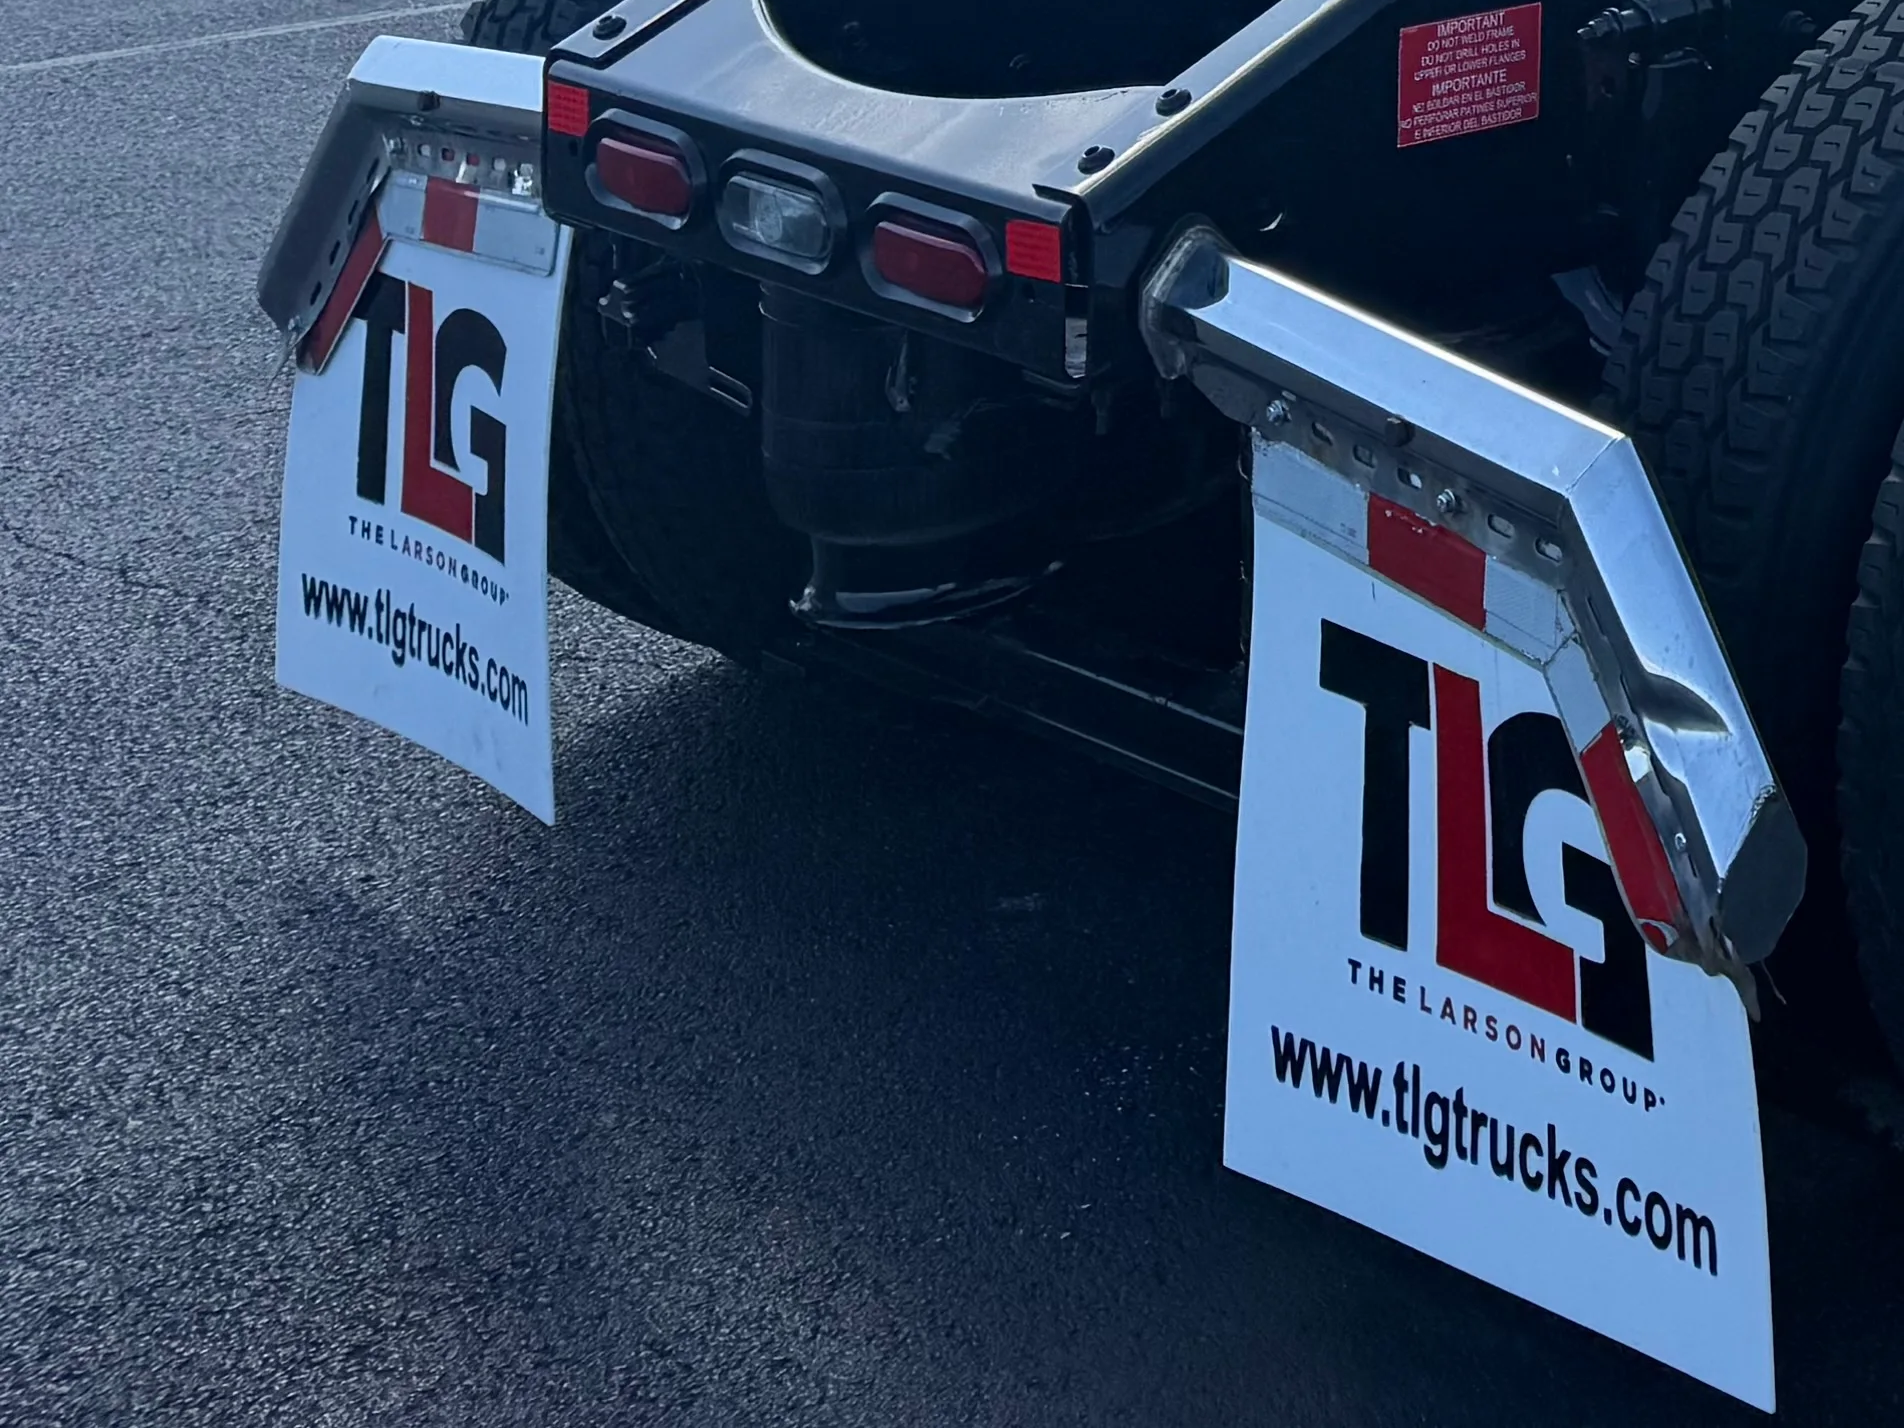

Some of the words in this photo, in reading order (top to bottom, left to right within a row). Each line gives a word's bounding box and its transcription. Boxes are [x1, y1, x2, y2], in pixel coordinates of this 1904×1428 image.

[1438, 11, 1505, 37] IMPORTANT
[1442, 36, 1459, 48] NOT
[1486, 26, 1514, 40] FRAME
[1444, 64, 1456, 75] OR
[1488, 50, 1526, 65] FLANGES
[1456, 47, 1478, 60] DRILL
[1482, 42, 1509, 54] HOLES
[1512, 38, 1520, 47] IN
[1432, 68, 1507, 96] IMPORTANTE
[1474, 90, 1484, 100] EL
[1482, 108, 1522, 125] BASTIDOR
[349, 271, 508, 566] TLG
[349, 515, 384, 546] THE
[390, 529, 457, 578] LARSON
[461, 564, 507, 606] GROUP
[301, 571, 530, 726] www.tlgtrucks.com
[1319, 618, 1655, 1062] TLG
[1347, 958, 1407, 1004] THE
[1419, 986, 1546, 1064] LARSON
[1555, 1046, 1661, 1113] GROUP
[1270, 1025, 1719, 1277] www.tlgtrucks.com
